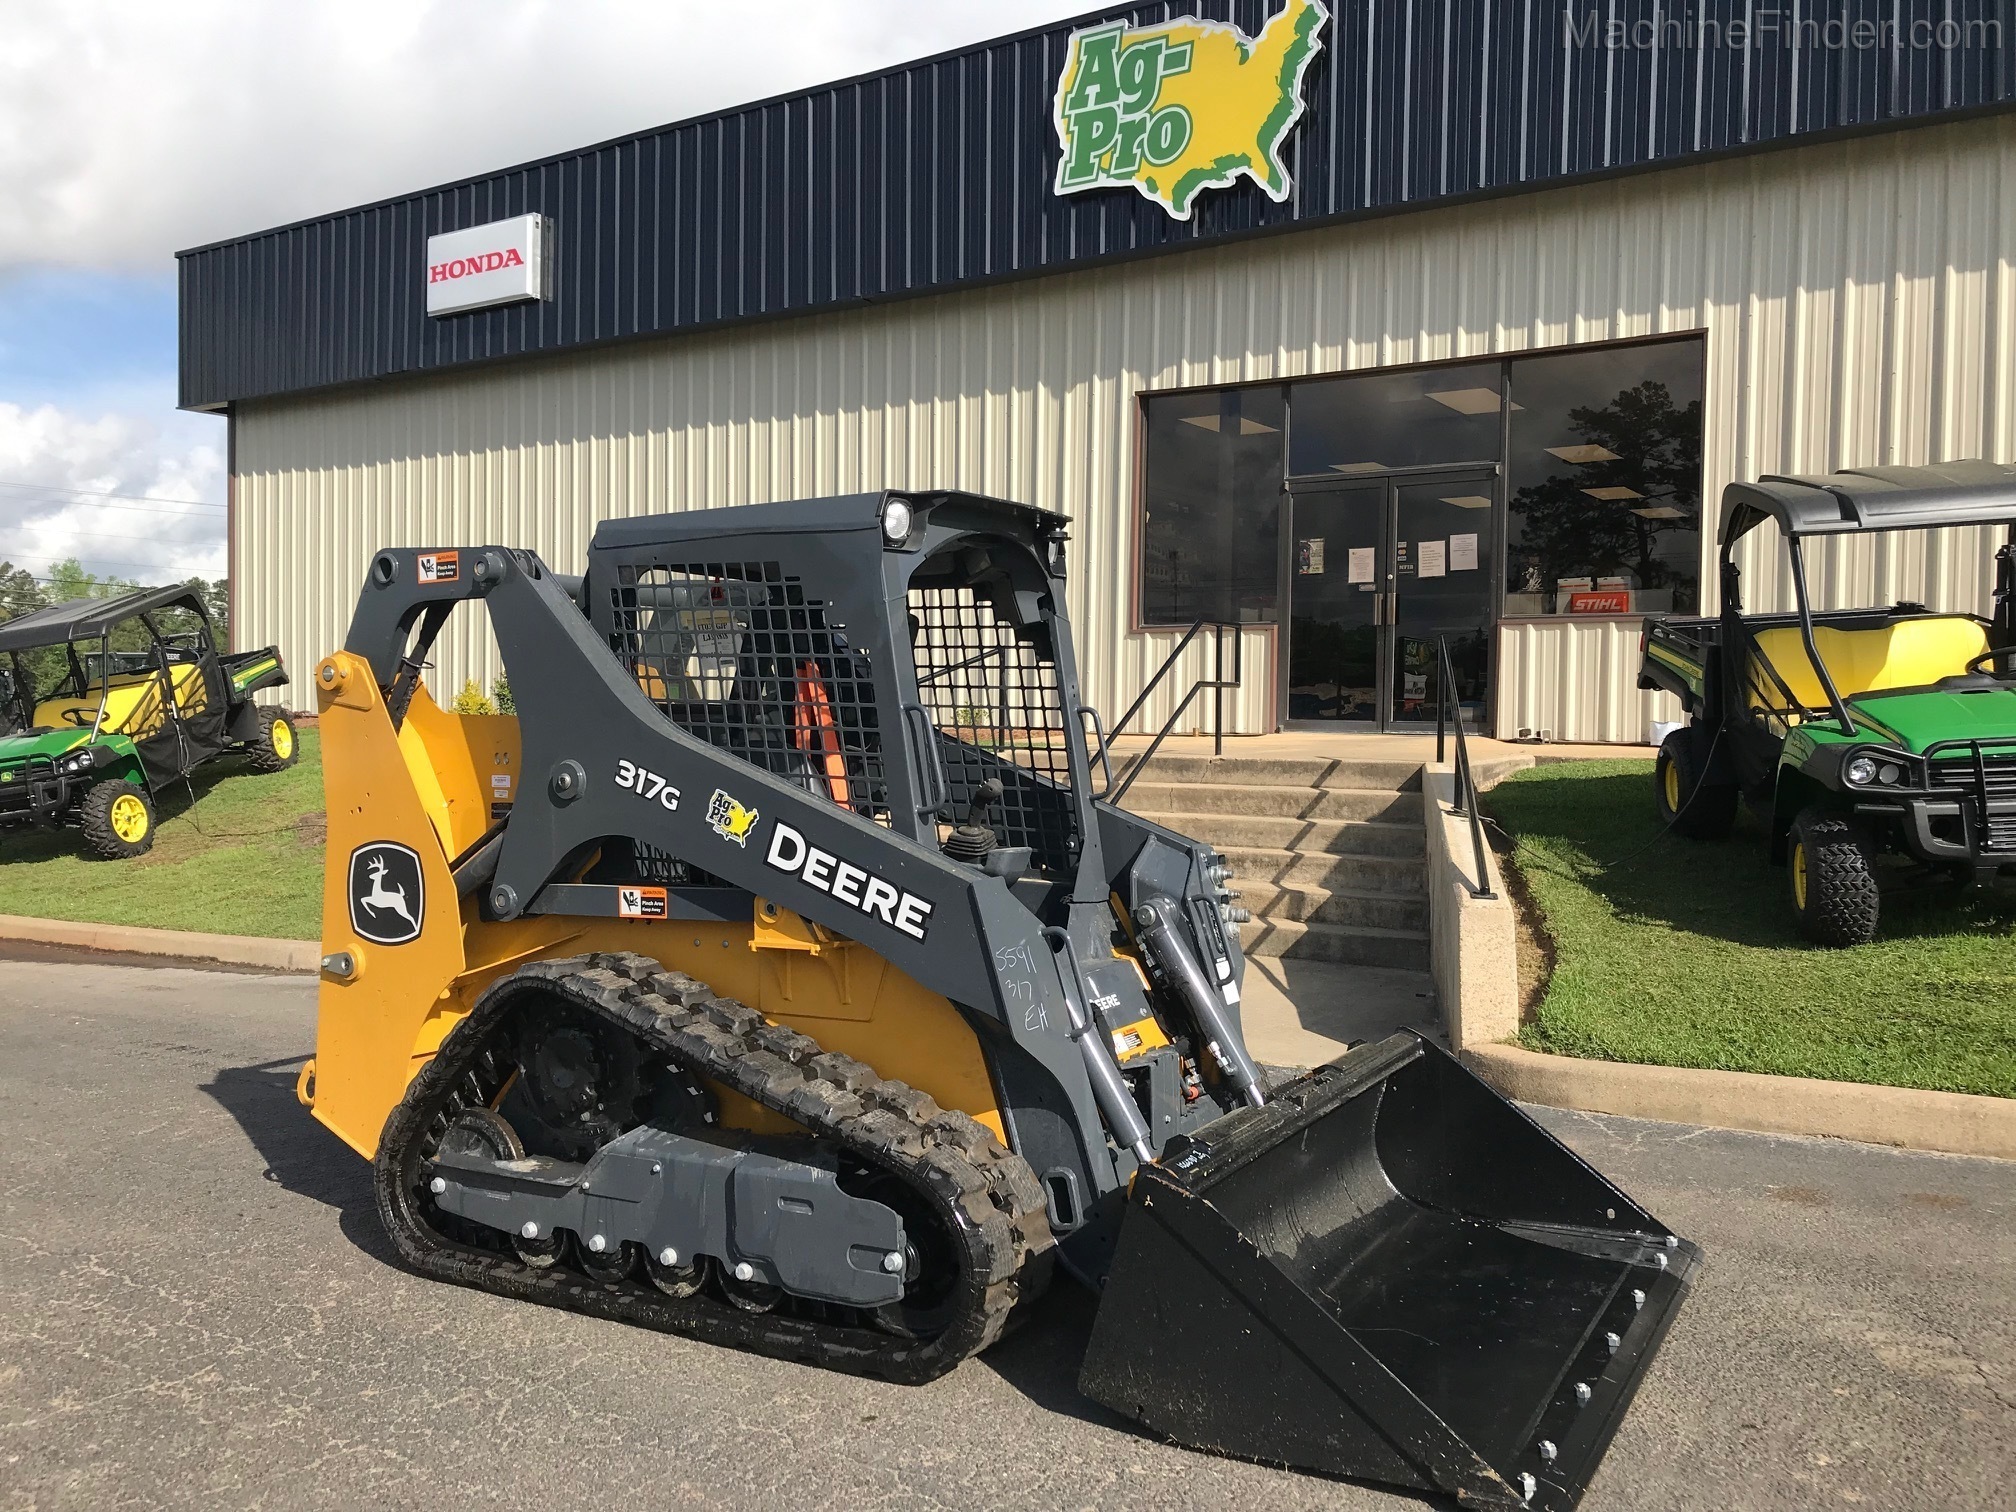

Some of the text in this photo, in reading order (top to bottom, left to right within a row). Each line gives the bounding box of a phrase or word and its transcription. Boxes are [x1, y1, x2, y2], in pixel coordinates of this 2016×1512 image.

[1066, 29, 1193, 115] Ag-
[1062, 105, 1192, 184] Pro
[430, 248, 524, 283] HONDA
[1573, 598, 1621, 610] STIHL
[615, 760, 681, 810] 317G
[710, 806, 731, 826] Pro
[713, 793, 735, 813] Ag-
[767, 822, 932, 939] DEERE
[996, 946, 1037, 973] 5591
[1005, 979, 1032, 1000] 317
